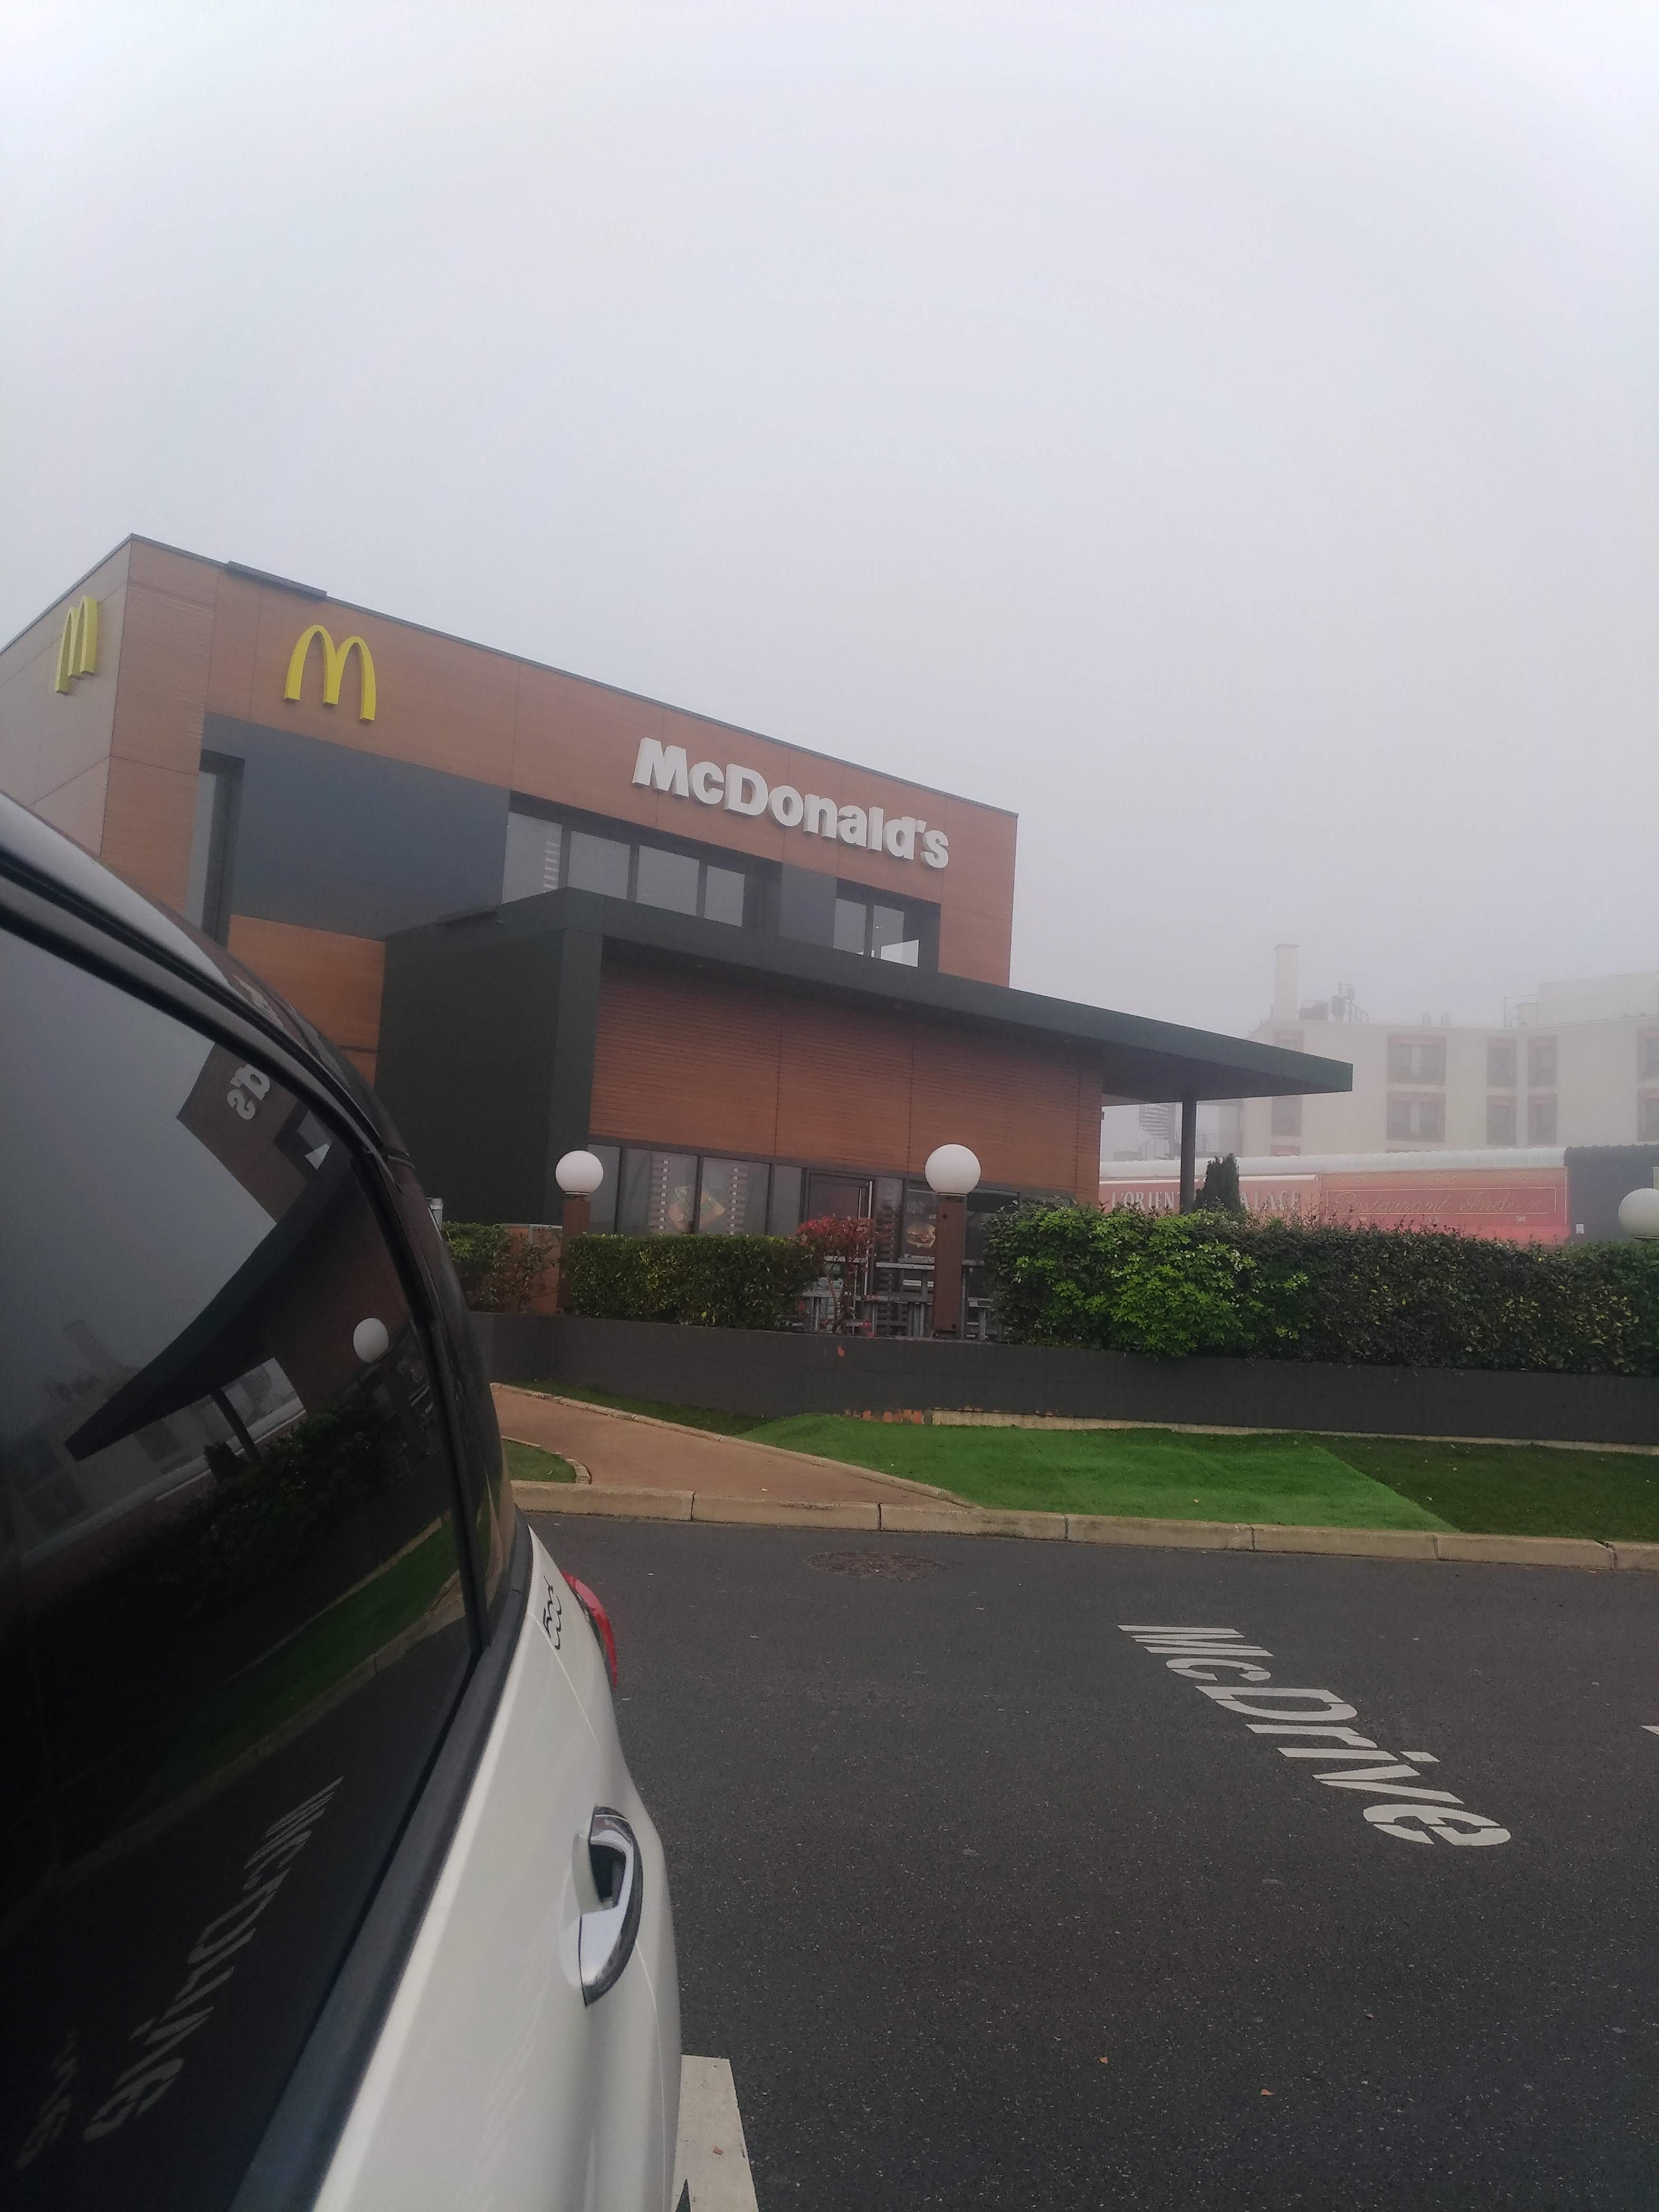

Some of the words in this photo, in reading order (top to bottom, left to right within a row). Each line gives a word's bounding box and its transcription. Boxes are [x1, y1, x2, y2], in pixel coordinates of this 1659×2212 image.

[631, 737, 949, 869] McDonald's
[1111, 1191, 1180, 1211] L'ORIEN
[1239, 1190, 1299, 1211] ALACE
[1335, 1192, 1451, 1212] Restaurant
[1460, 1191, 1545, 1212] Indien
[1117, 1624, 1511, 1847] McDrive
